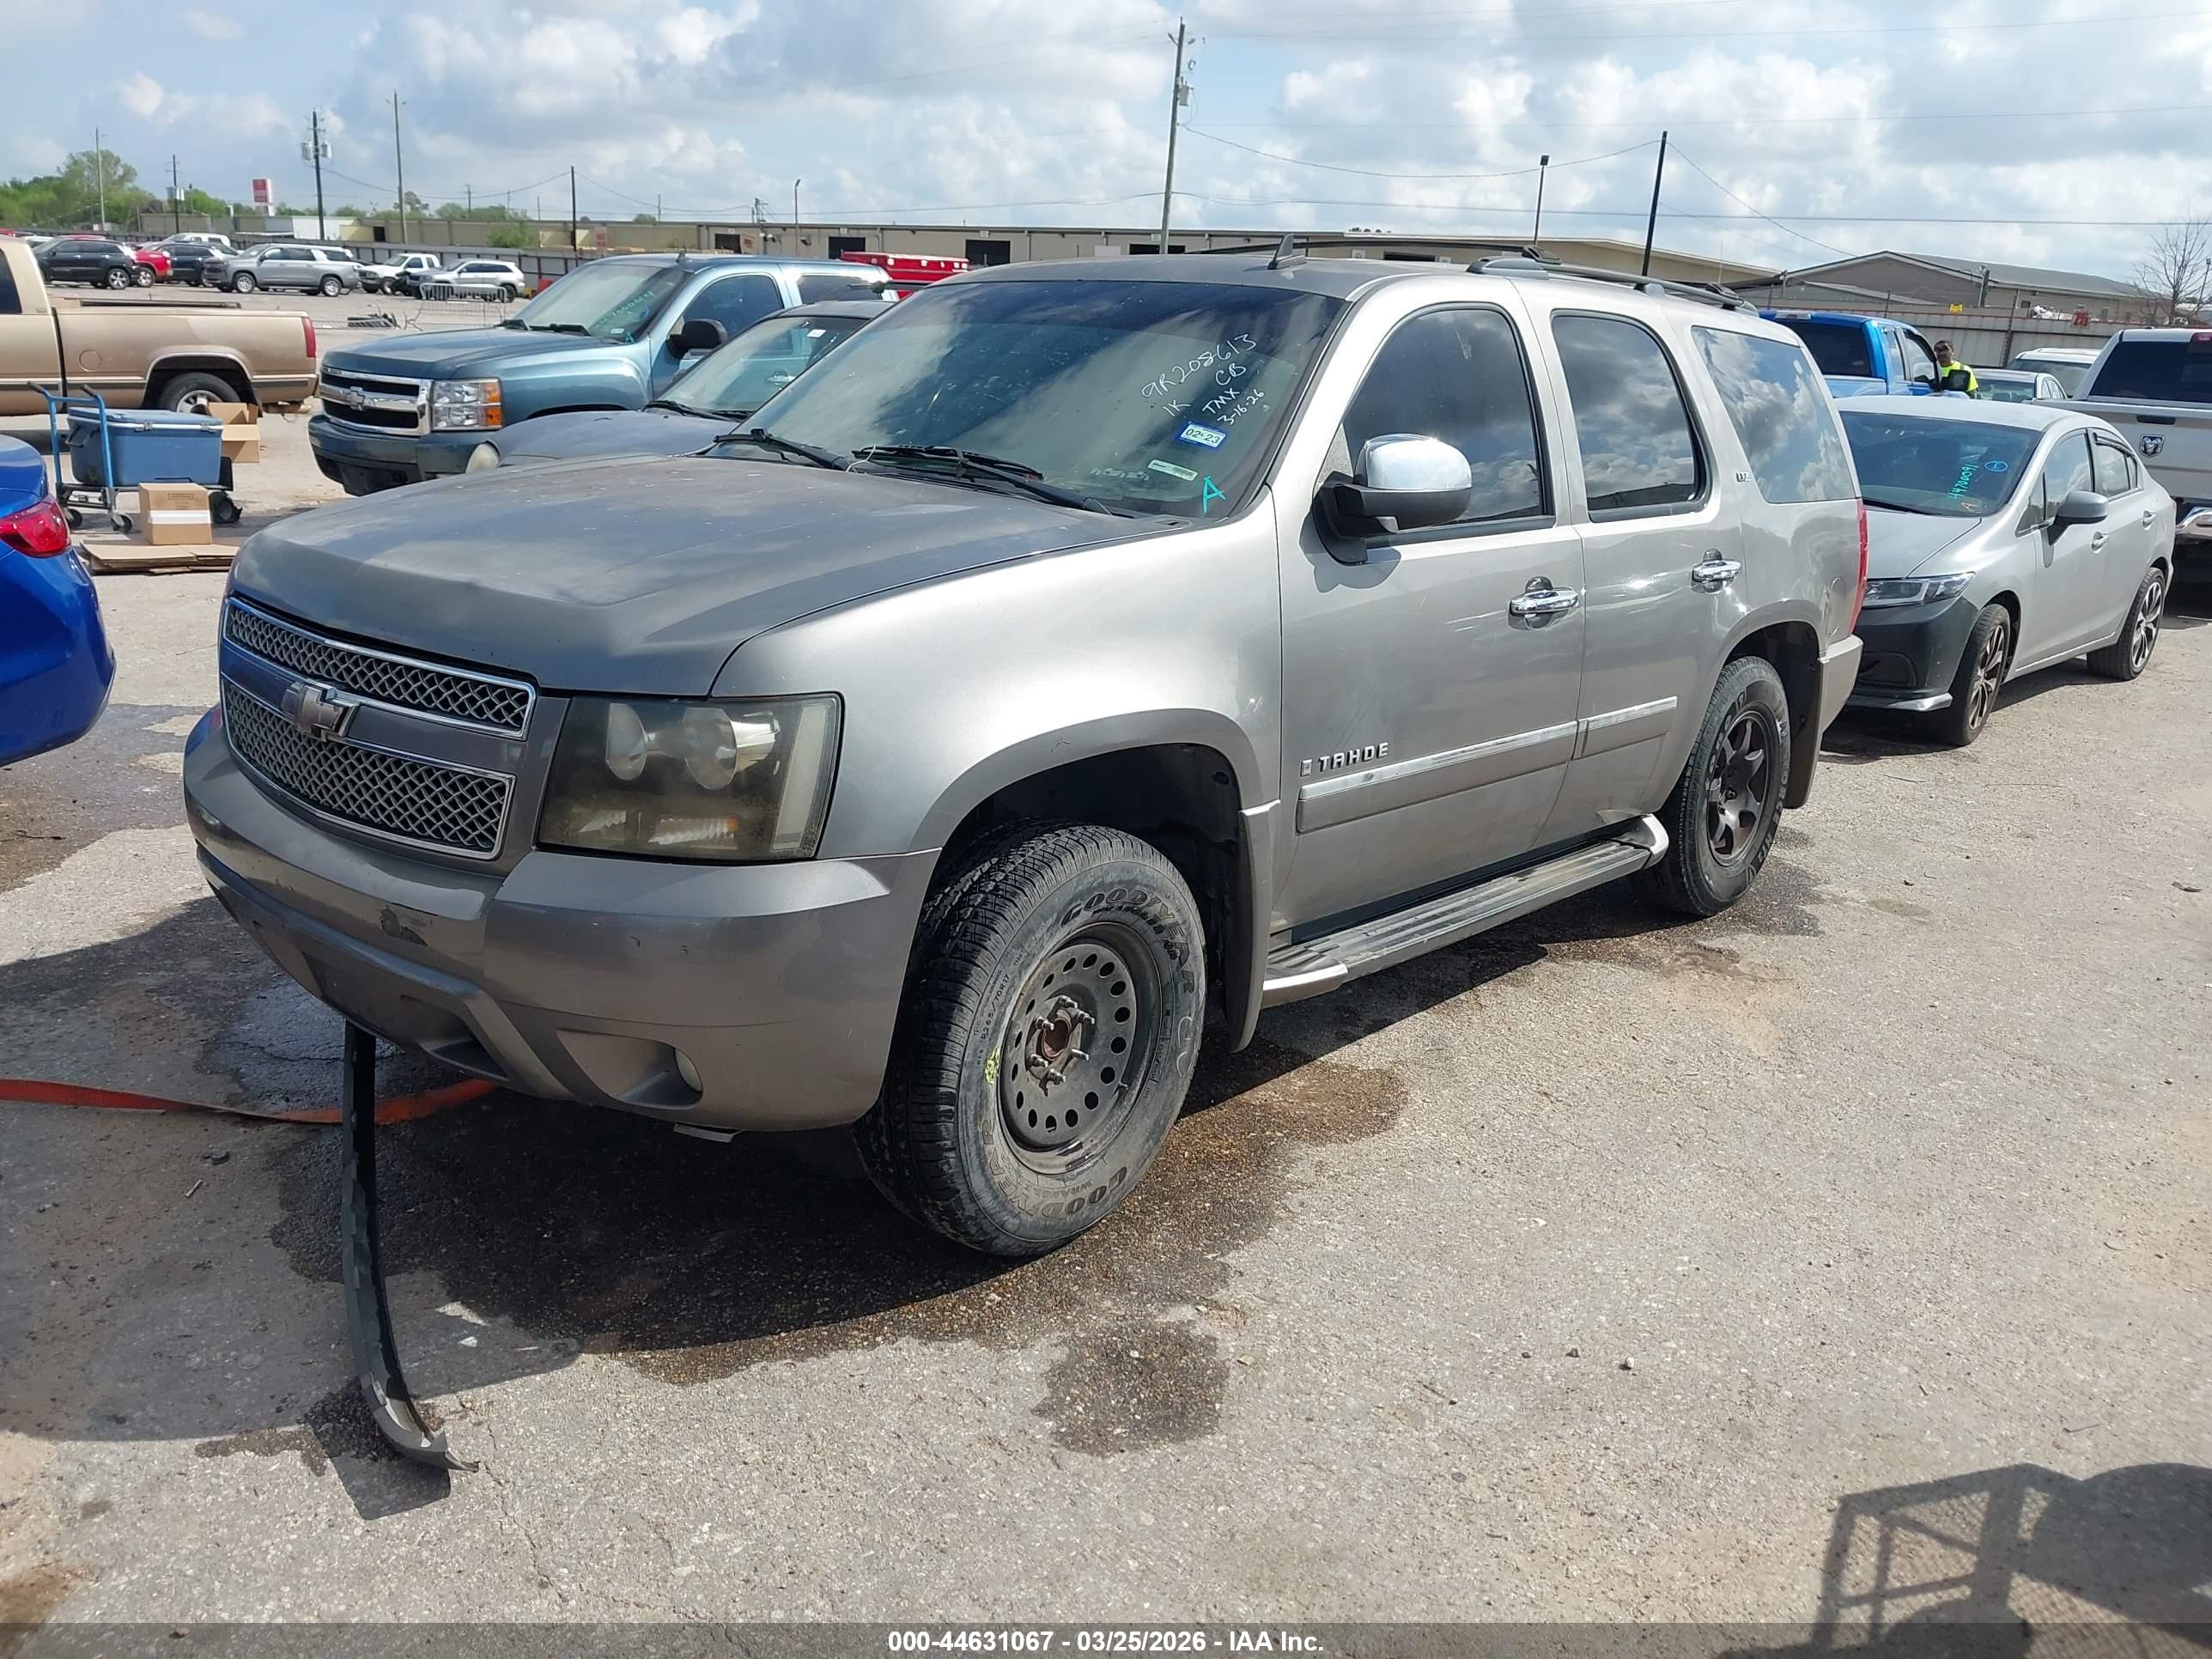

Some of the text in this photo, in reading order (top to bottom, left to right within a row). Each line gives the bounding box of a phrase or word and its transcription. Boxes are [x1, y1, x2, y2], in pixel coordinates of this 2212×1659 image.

[1141, 332, 1257, 399] 9R208613
[1215, 362, 1247, 386] CB
[1202, 386, 1241, 415] TMX
[1217, 388, 1265, 426] 3-16-26
[1185, 428, 1221, 444] 02 23
[1201, 475, 1227, 514] A
[1318, 743, 1389, 772] TAHOE
[1060, 887, 1195, 994] GOODYEAR
[981, 1119, 1127, 1218] GOODYEAR
